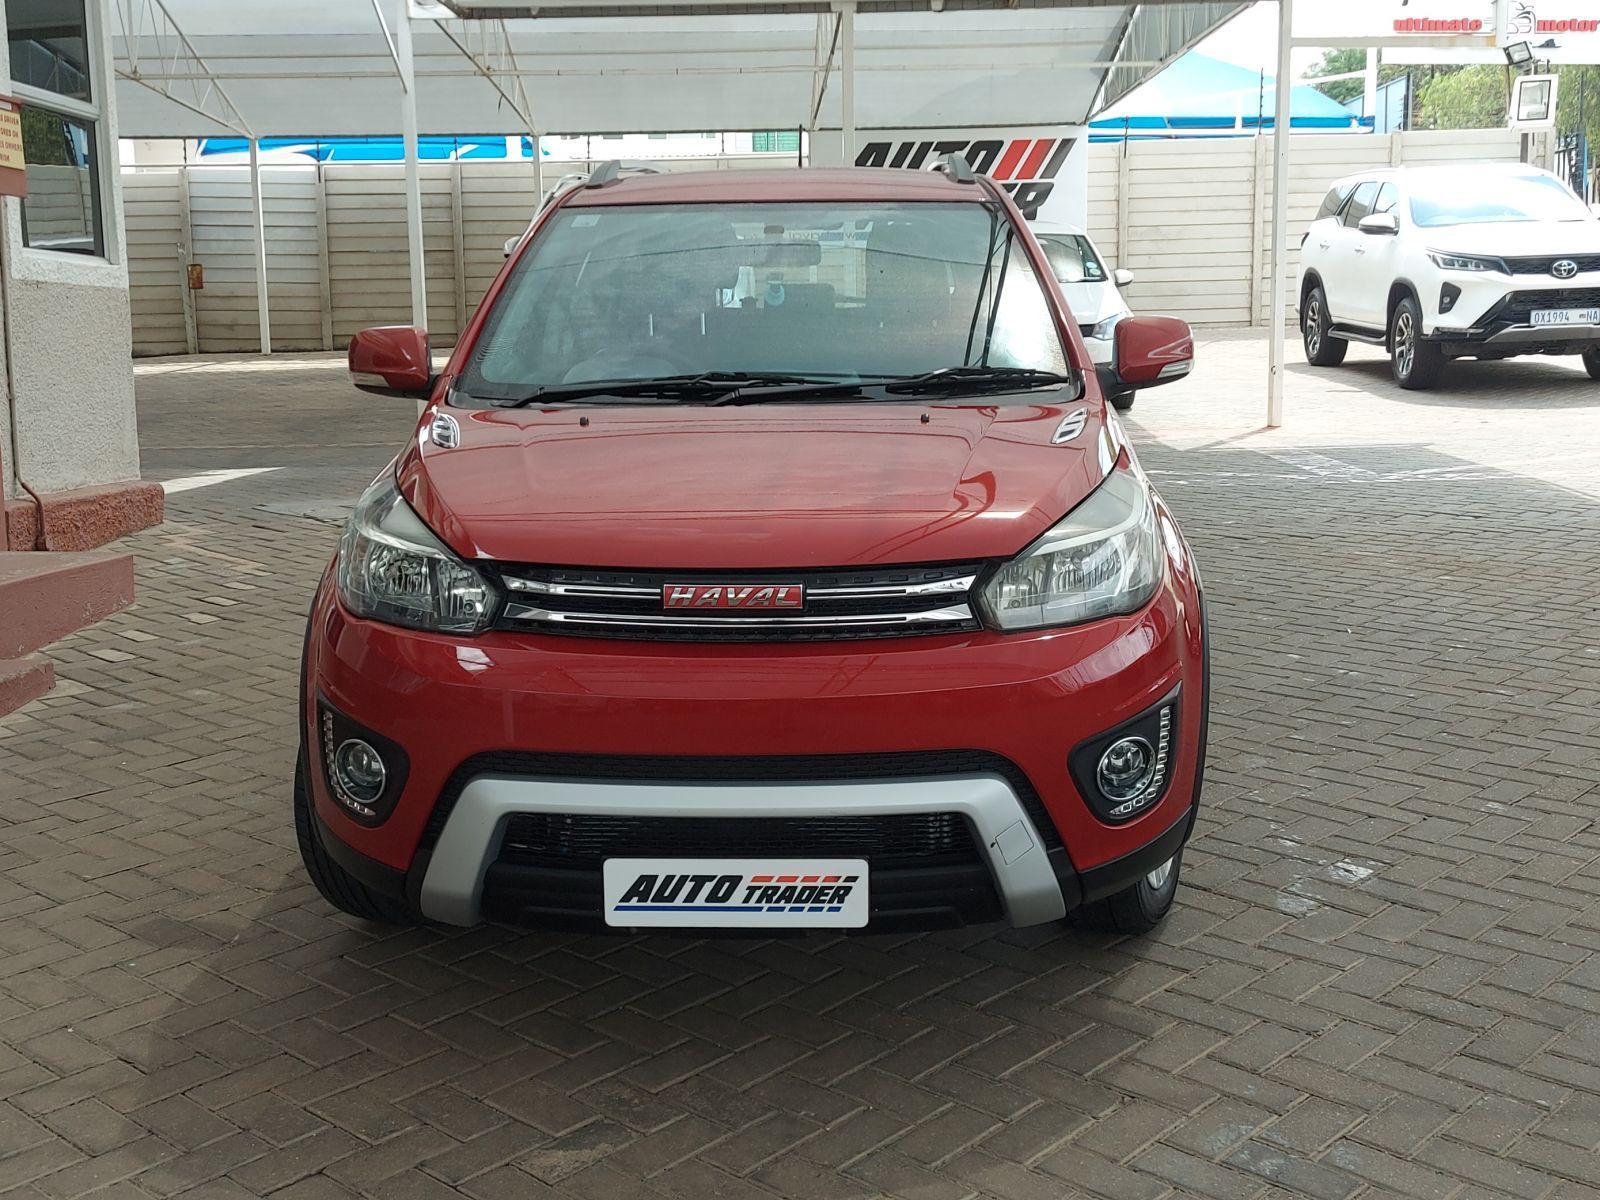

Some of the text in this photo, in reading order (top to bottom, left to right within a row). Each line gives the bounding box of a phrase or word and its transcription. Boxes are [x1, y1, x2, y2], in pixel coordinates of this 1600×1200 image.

[1393, 17, 1482, 32] ultimate
[668, 587, 799, 606] HAVAL
[618, 874, 853, 904] AUTO TRADER
